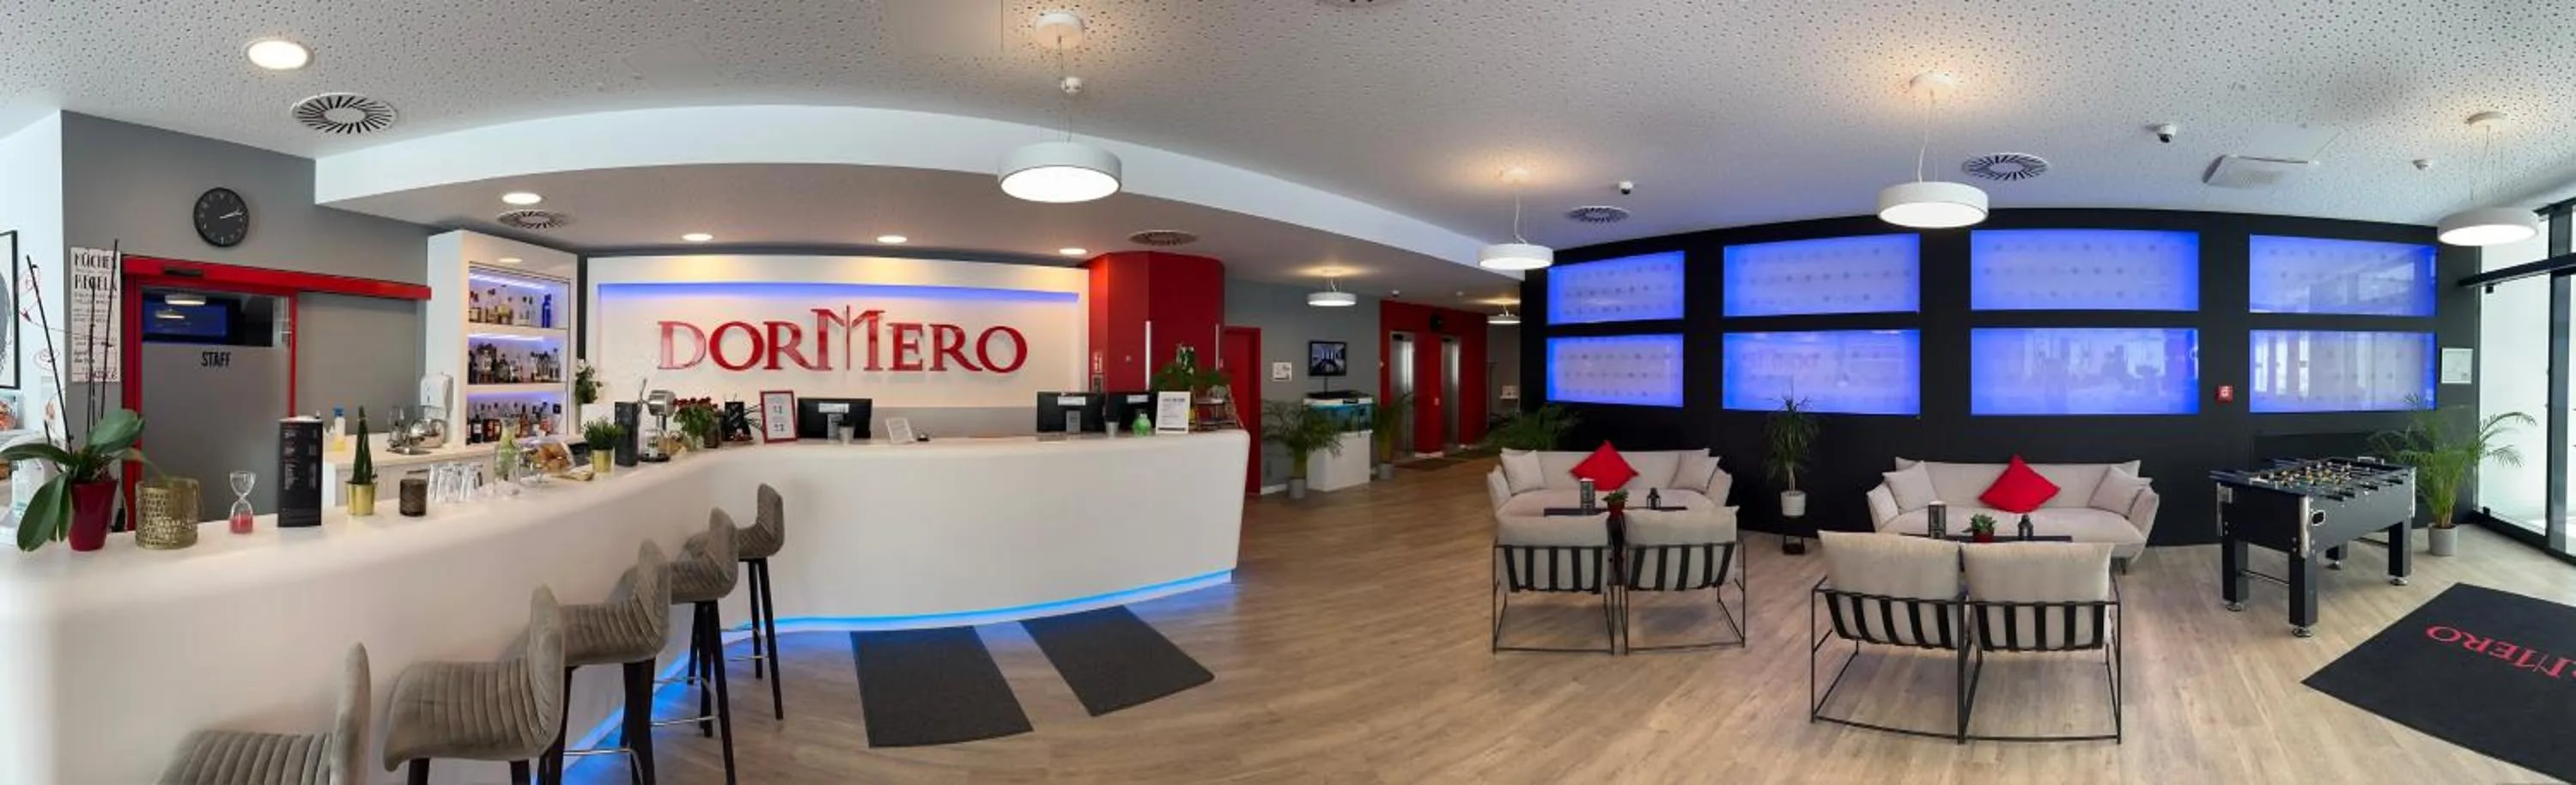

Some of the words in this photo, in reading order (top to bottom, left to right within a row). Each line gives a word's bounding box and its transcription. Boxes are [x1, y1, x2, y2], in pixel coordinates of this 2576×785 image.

[201, 351, 231, 368] STAFF
[658, 305, 1028, 373] DORMERO
[2426, 626, 2576, 679] MERO
